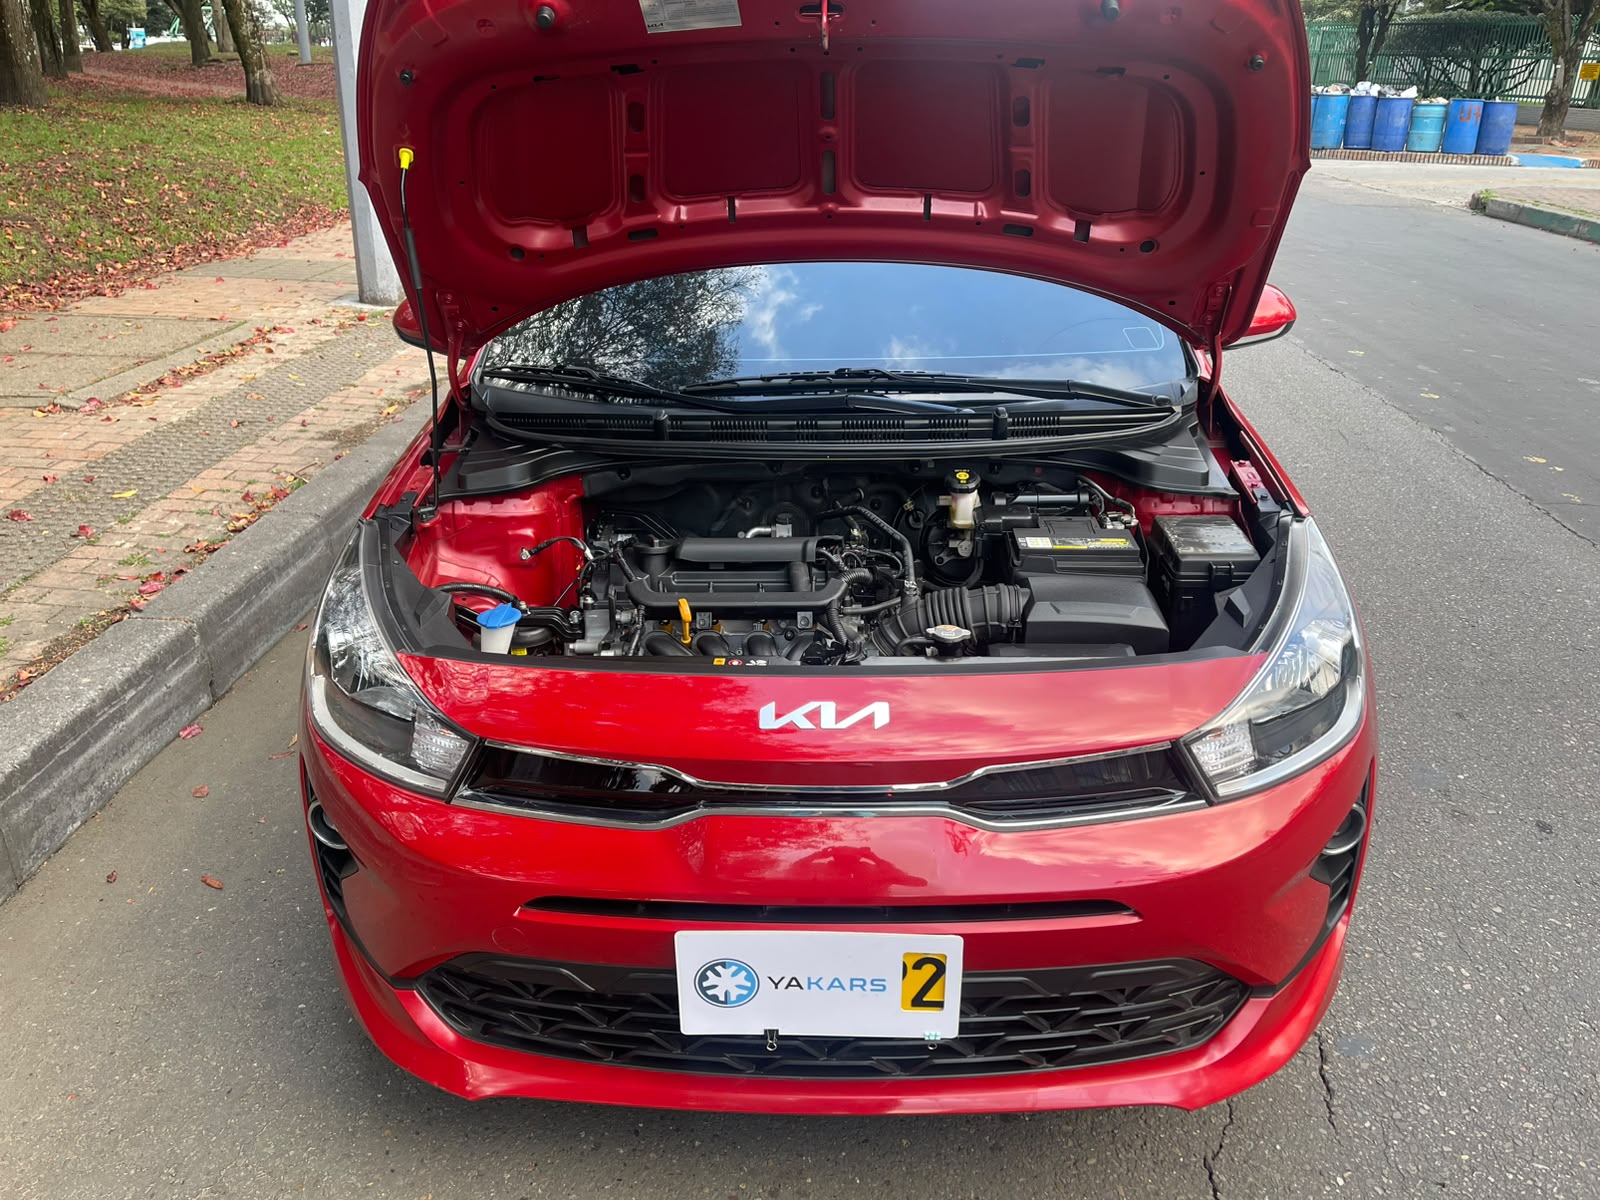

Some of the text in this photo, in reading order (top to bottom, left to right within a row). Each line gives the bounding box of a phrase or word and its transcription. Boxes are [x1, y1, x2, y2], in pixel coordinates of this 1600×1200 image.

[759, 701, 890, 730] KIA
[767, 976, 887, 992] YAKARS
[902, 957, 946, 1009] 2
